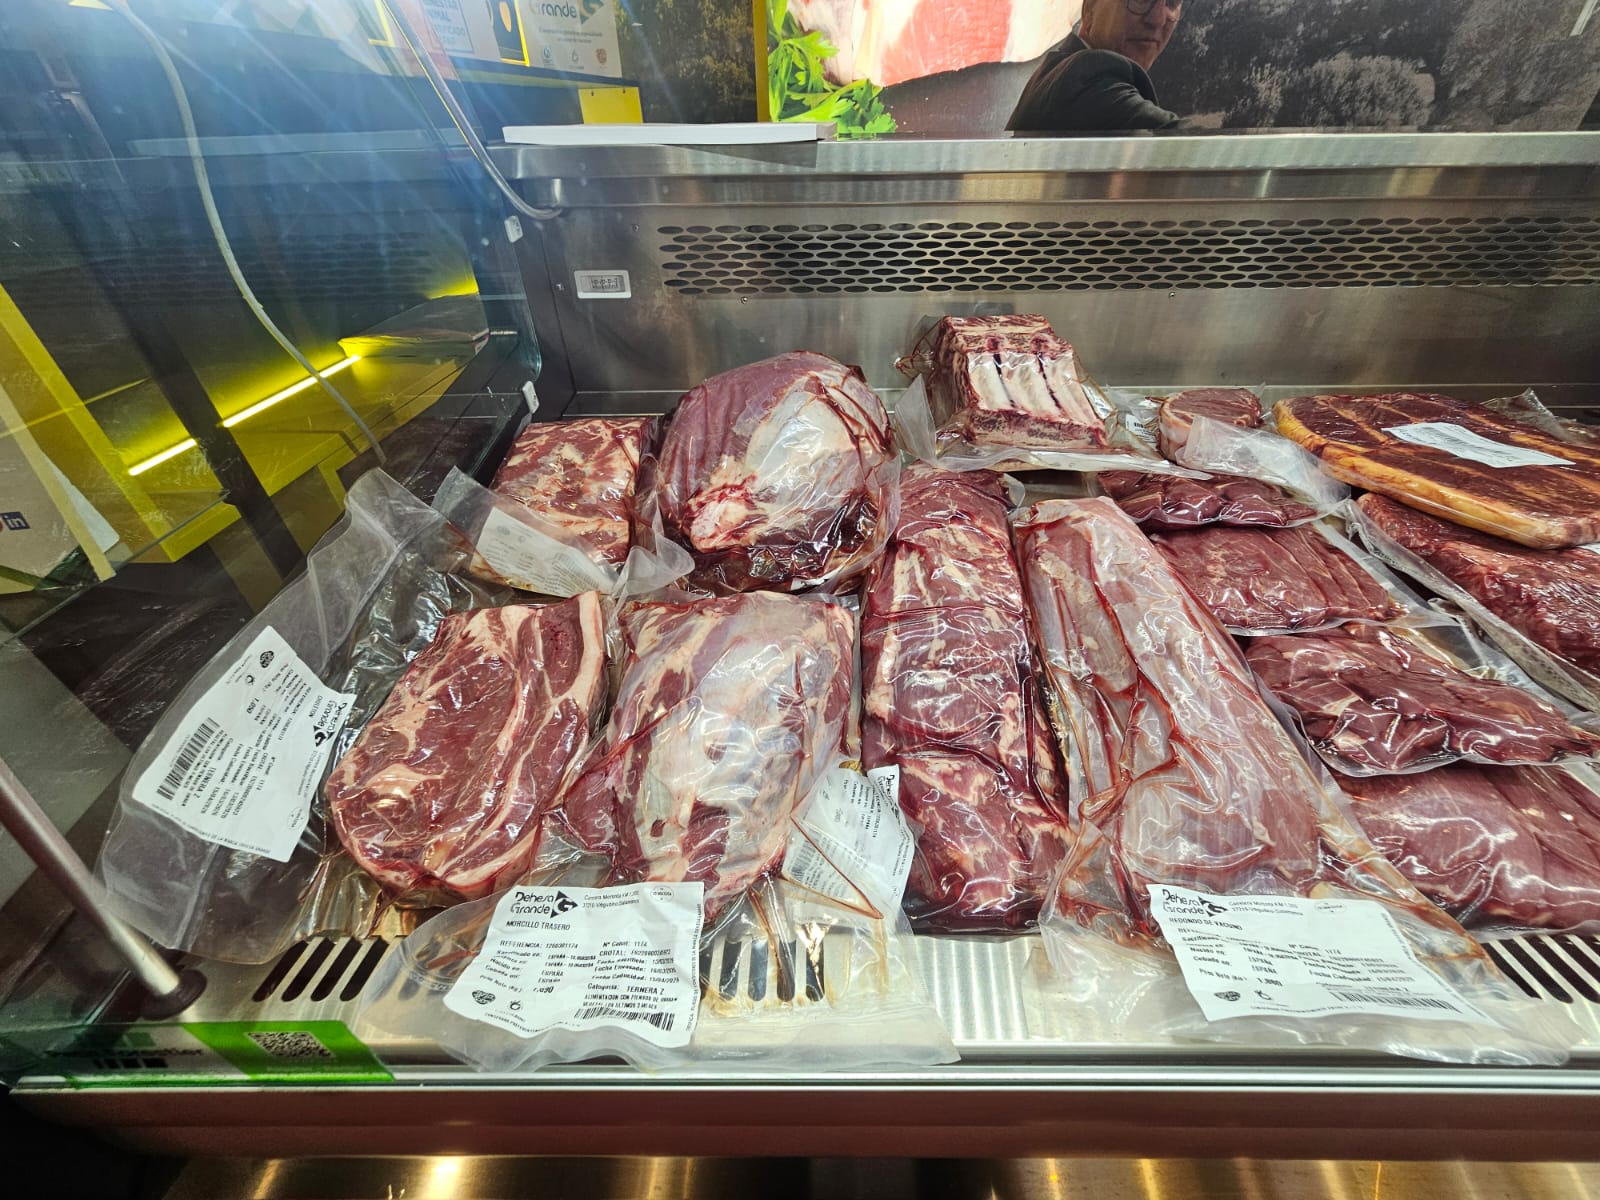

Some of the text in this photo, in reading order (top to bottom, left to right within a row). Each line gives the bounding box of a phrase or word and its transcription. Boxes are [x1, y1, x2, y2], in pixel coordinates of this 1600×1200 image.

[317, 700, 337, 727] Grande
[515, 892, 554, 902] Dehesa
[1162, 888, 1200, 906] Dehesa
[510, 902, 550, 914] Grande
[1163, 902, 1205, 915] Grande
[506, 921, 570, 930] MORCILLO TRASERO
[1169, 917, 1202, 925] REDONDO
[1215, 920, 1243, 931] VACUNO
[626, 986, 657, 994] TERNERA
